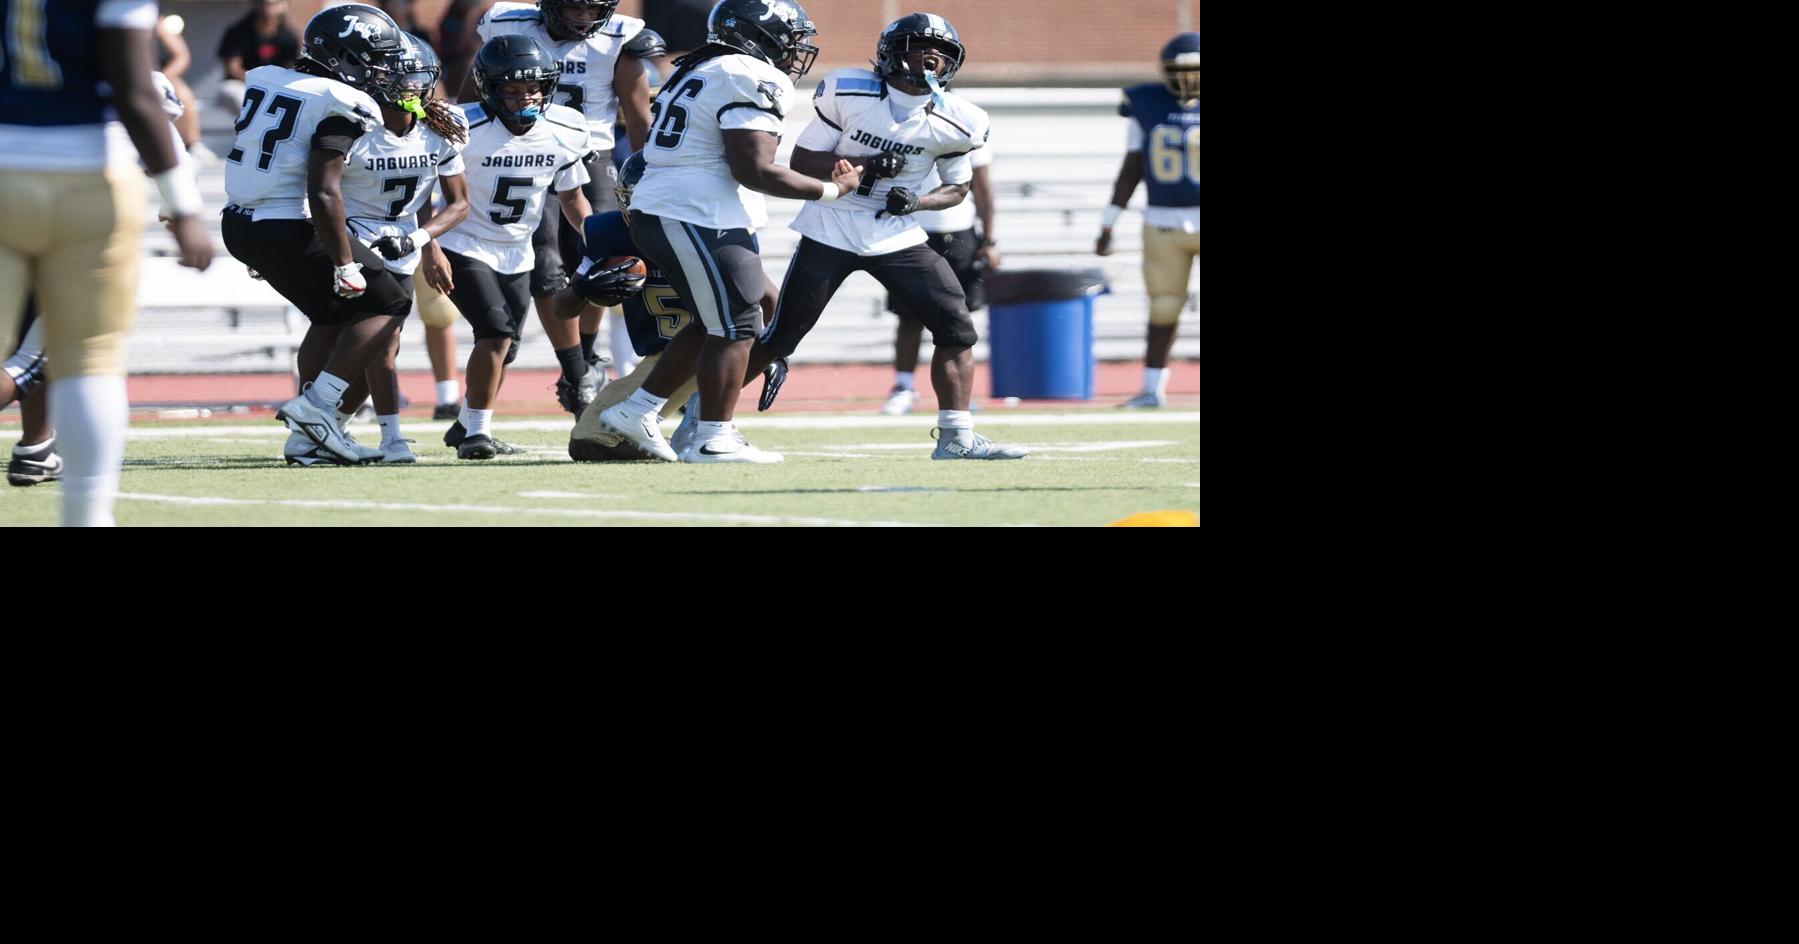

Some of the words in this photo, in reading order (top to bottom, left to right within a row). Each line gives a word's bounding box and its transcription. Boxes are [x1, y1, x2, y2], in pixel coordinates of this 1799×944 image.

[226, 85, 306, 173] 27
[850, 129, 925, 155] JAGUARS
[365, 153, 438, 171] JAGUARS
[481, 154, 556, 168] JAGUARS
[380, 174, 421, 224] 7
[488, 174, 536, 226] 5
